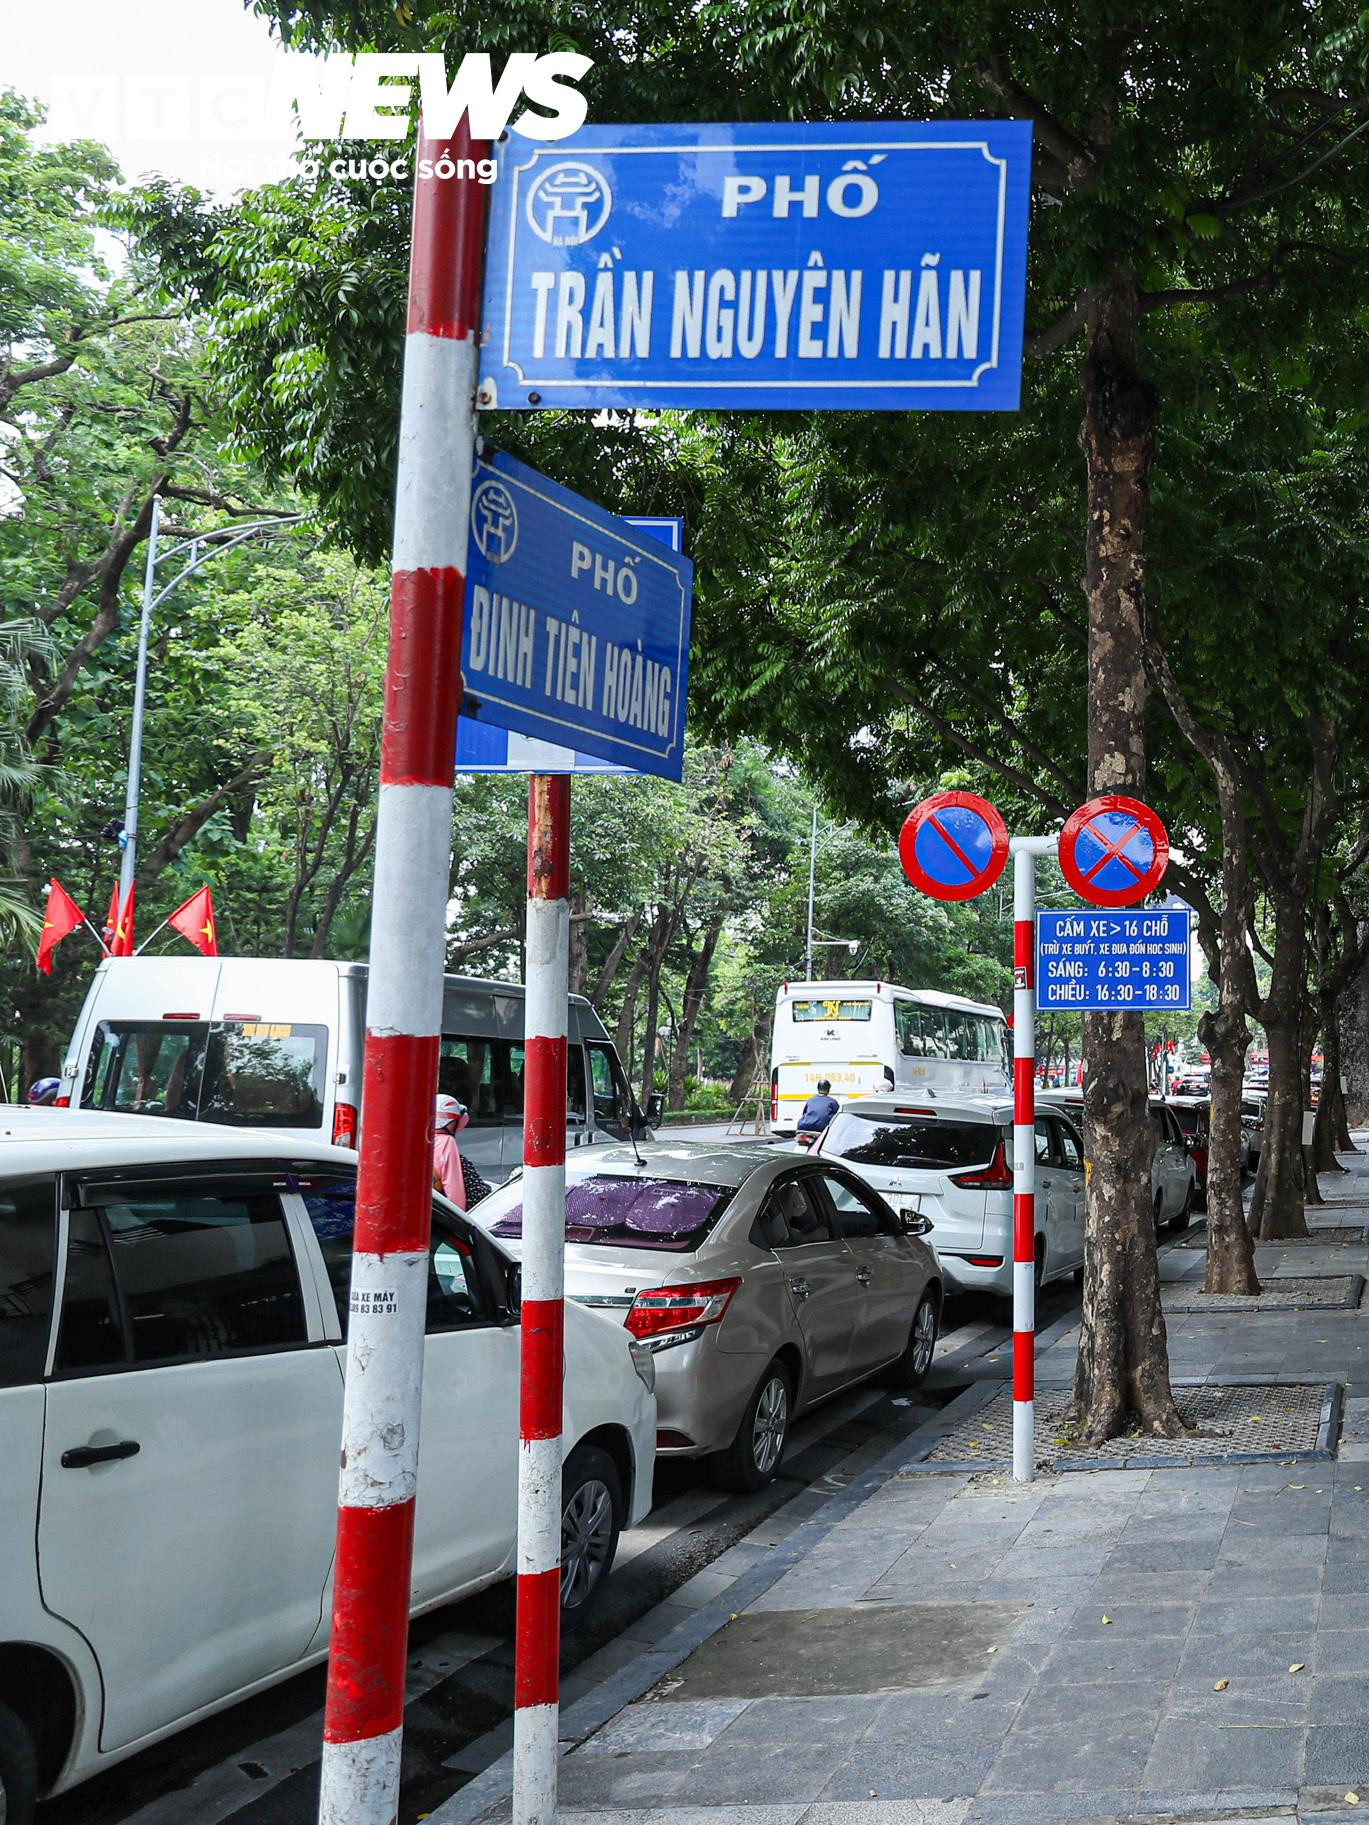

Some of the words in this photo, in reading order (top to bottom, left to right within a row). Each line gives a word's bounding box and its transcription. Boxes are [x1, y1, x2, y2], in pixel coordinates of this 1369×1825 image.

[721, 153, 887, 219] PHỐ
[530, 246, 653, 359] TRẦN
[669, 250, 862, 359] NGUYÊN
[877, 252, 981, 360] HÃN
[571, 540, 641, 605] PHỐ
[469, 584, 536, 689] ĐINH
[544, 609, 597, 711] TIÊN
[601, 637, 672, 738] HOÀNG
[1056, 915, 1085, 937] CẤM
[1143, 914, 1169, 937] CHỖ
[1061, 943, 1073, 955] XE
[1099, 943, 1110, 955] XE
[1129, 939, 1146, 955] ĐÓN
[1163, 942, 1187, 956] SINH)
[1048, 957, 1089, 978] SÁNG:
[1048, 979, 1090, 1001] CHIỀU:
[361, 1292, 371, 1302] XE
[373, 1290, 395, 1302] MÁY
[372, 1304, 383, 1313] 83
[386, 1303, 397, 1313] 91
